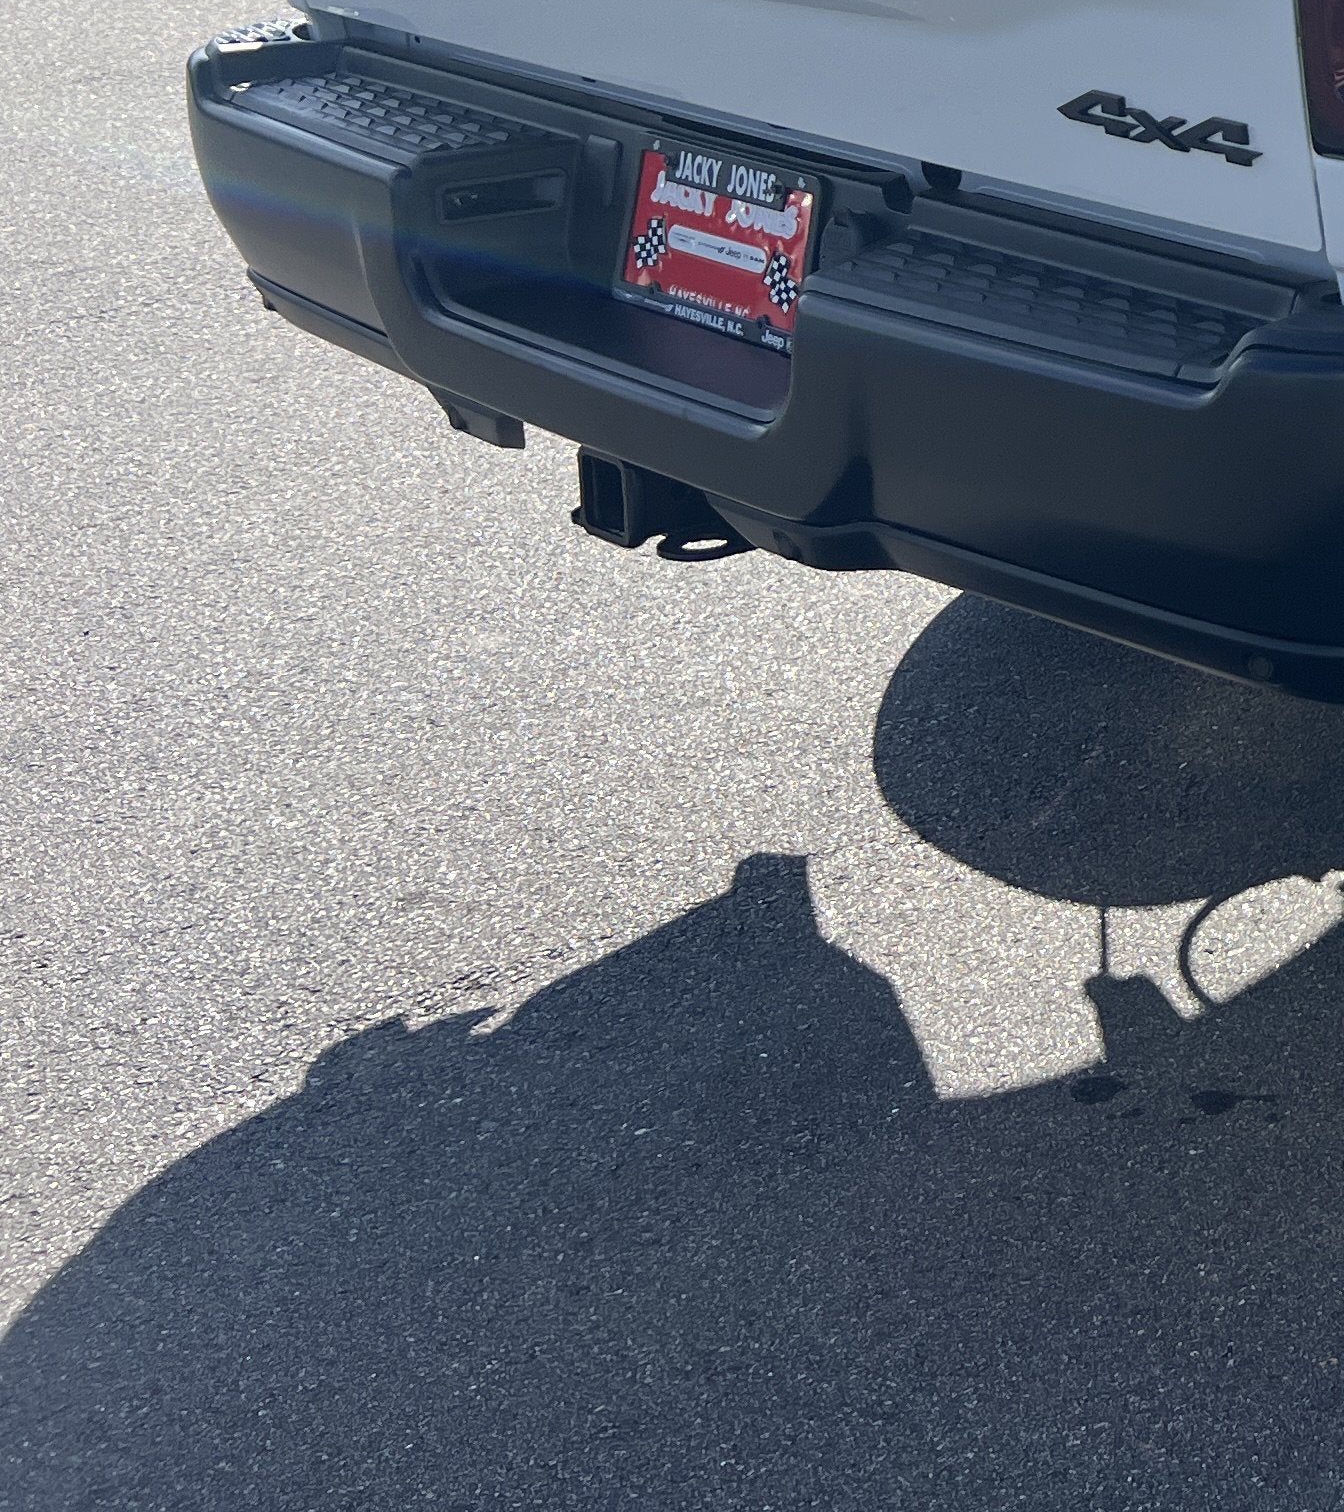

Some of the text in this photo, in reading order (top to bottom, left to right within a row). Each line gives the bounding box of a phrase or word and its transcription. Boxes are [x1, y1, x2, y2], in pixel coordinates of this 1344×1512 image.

[674, 150, 777, 203] JACKY JONES
[760, 329, 785, 350] Jeep
